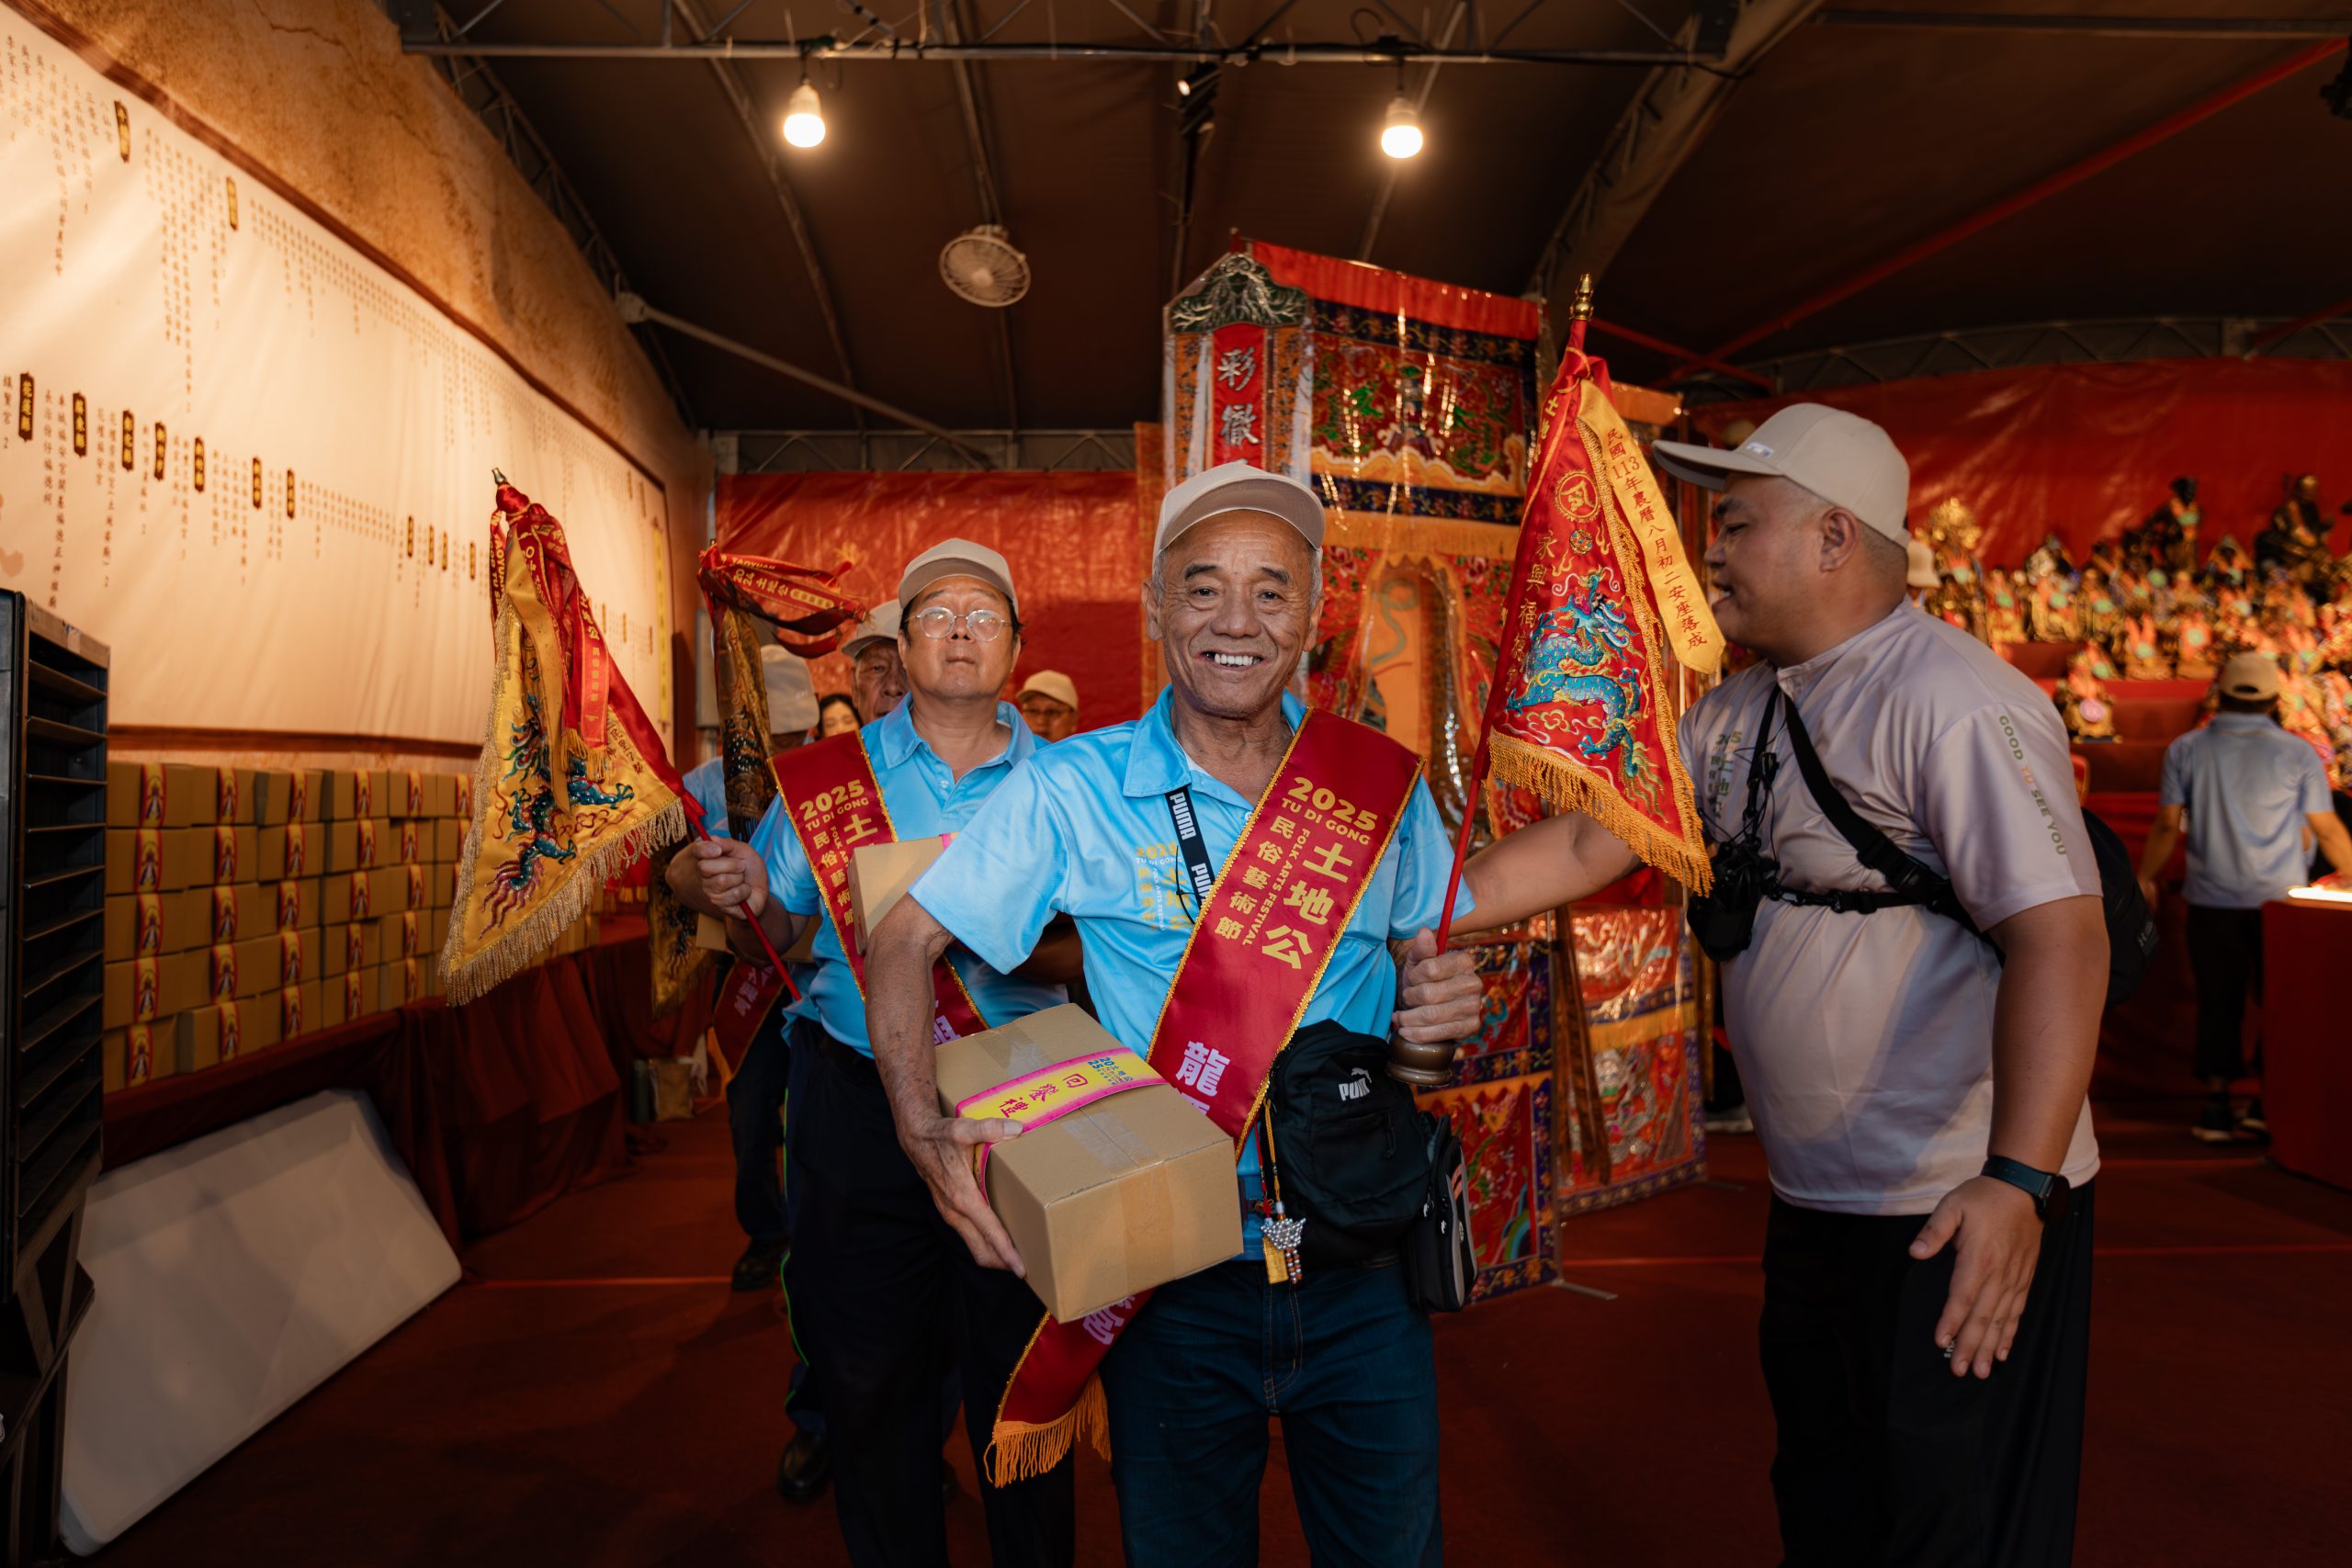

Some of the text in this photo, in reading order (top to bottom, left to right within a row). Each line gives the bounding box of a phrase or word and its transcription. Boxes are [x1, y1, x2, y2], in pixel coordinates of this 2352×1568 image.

[1217, 346, 1260, 467] 彩徹
[798, 779, 865, 821] 2025
[805, 797, 870, 831] TU DI GONG
[1170, 792, 1197, 840] PUMA
[1287, 776, 1378, 831] 2025
[1999, 715, 2024, 761] GOOD
[2030, 789, 2051, 818] SEE
[2047, 821, 2067, 856] YOU
[830, 826, 843, 850] FOLK
[1282, 797, 1371, 846] TU DI GONG
[1215, 816, 1296, 940] 民俗藝術節
[1241, 828, 1311, 946] FOLK ARTS FESTIVAL
[1262, 842, 1353, 970] 土地公
[1176, 1040, 1231, 1116] 龍
